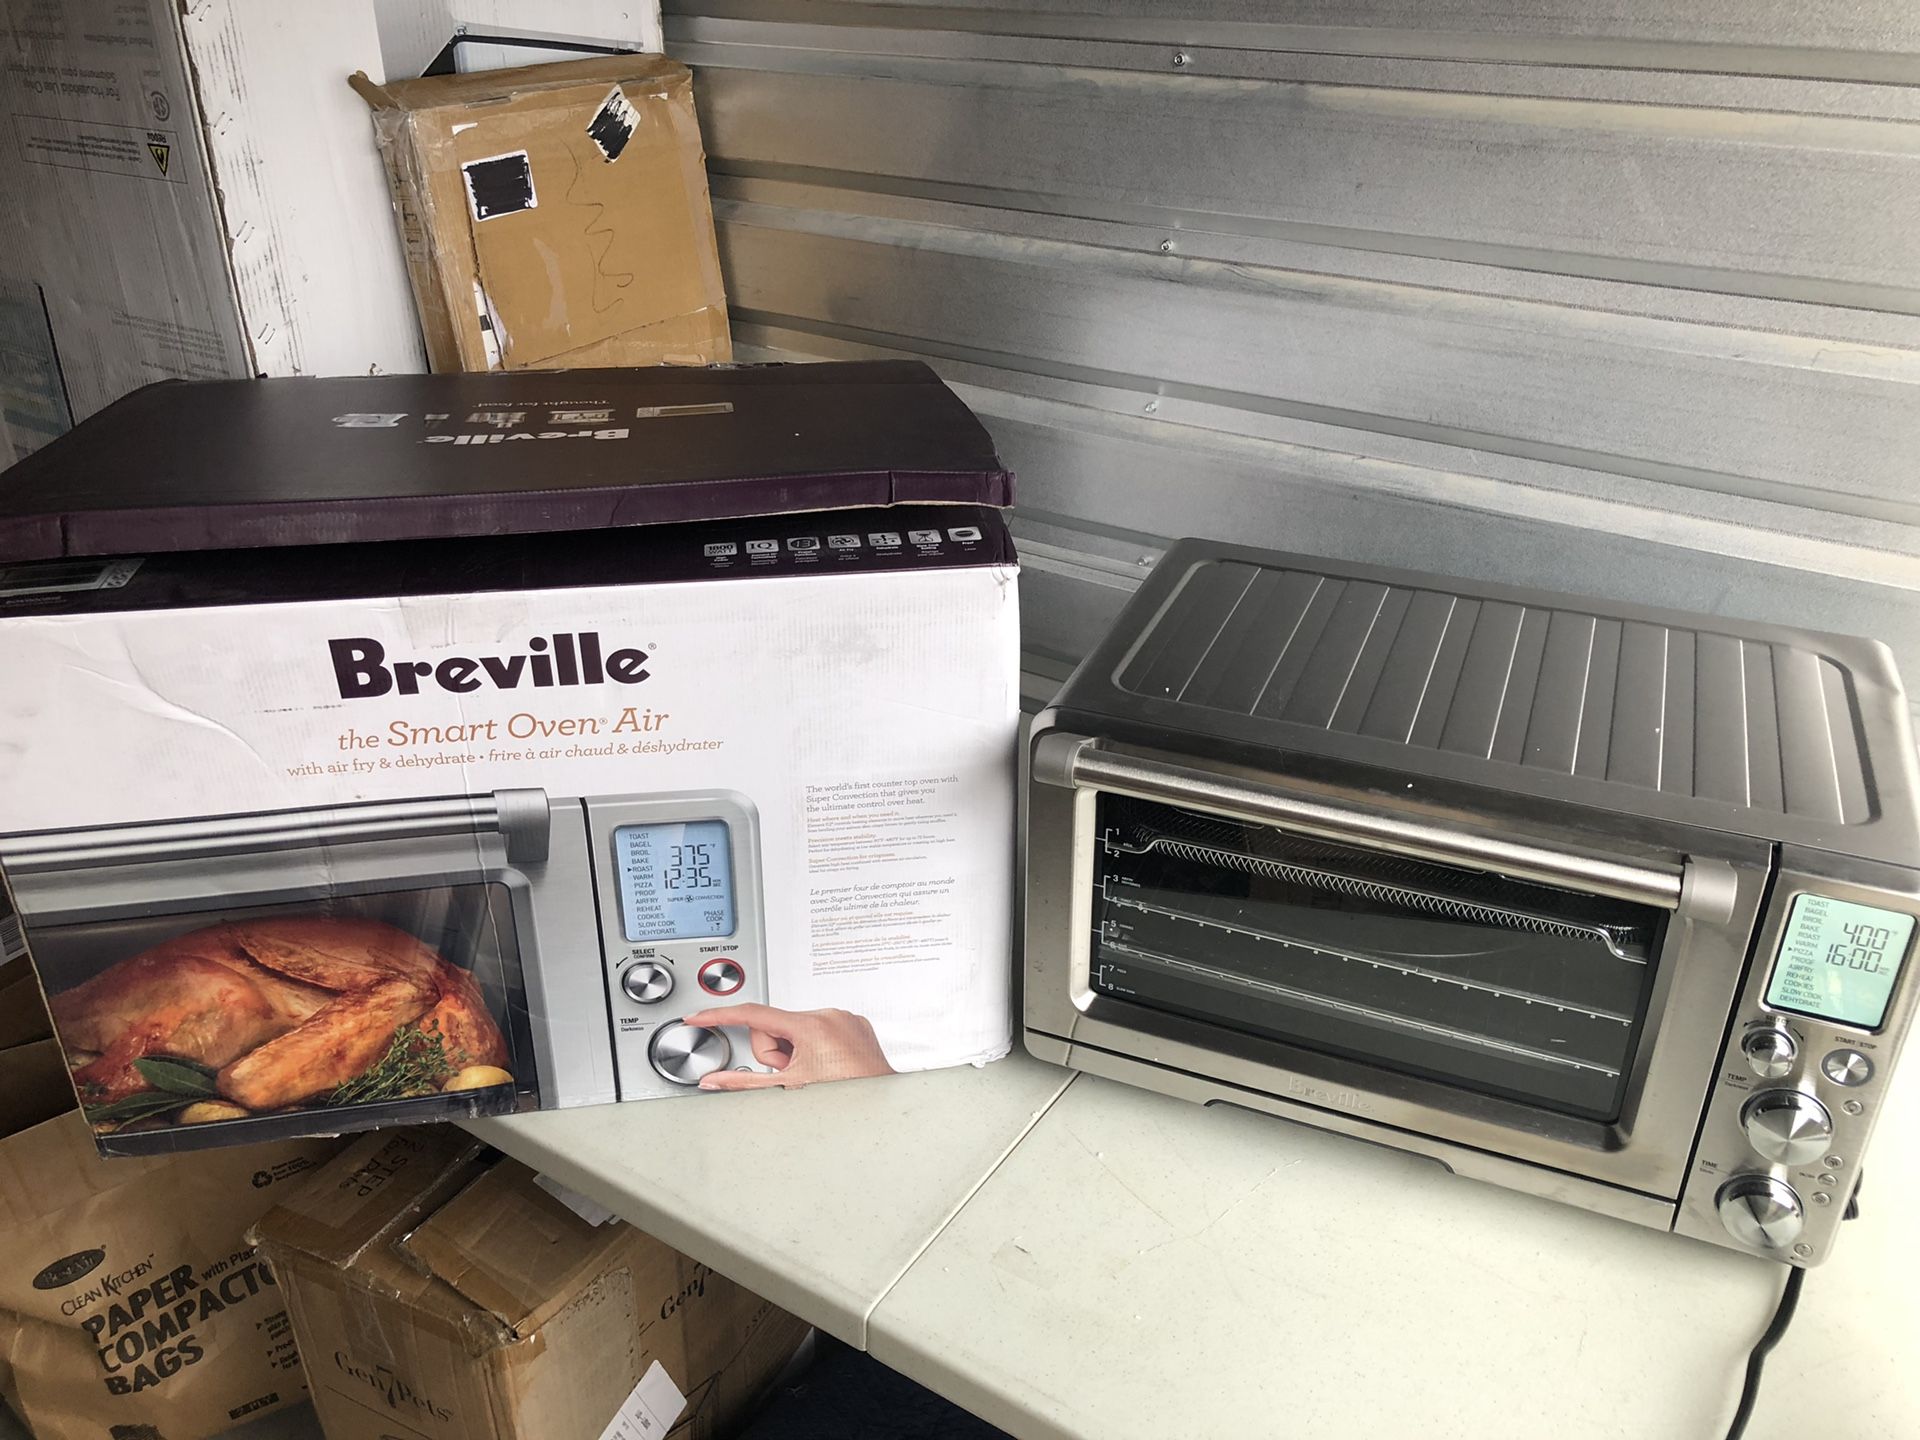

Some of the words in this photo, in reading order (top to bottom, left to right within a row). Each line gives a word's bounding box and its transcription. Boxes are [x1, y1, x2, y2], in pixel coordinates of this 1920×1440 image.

[424, 429, 629, 445] Breville
[328, 631, 652, 699] Breville
[338, 728, 379, 751] the
[387, 716, 498, 748] Smart
[507, 712, 600, 740] Oven
[613, 707, 670, 733] Air
[287, 763, 324, 777] with
[327, 758, 349, 773] air
[352, 755, 375, 774] fry
[379, 755, 391, 768] &
[395, 749, 476, 769] dehydrate
[488, 747, 521, 763] frire
[525, 746, 535, 760] à
[538, 745, 561, 760] air
[564, 742, 614, 758] chaud
[617, 741, 628, 754] &
[632, 738, 724, 756] déshydrater
[824, 782, 853, 792] world's
[854, 782, 870, 790] first
[872, 780, 903, 789] counter
[904, 778, 918, 787] top
[940, 774, 959, 783] with
[806, 795, 831, 804] Super
[832, 791, 879, 801] Convection
[880, 789, 896, 797] that
[898, 788, 919, 798] gives
[920, 787, 936, 796] you
[807, 804, 820, 812] the
[821, 802, 856, 812] ultimate
[857, 800, 886, 809] control
[887, 798, 906, 807] over
[906, 796, 926, 805] heat.
[1116, 828, 1120, 836] 1
[670, 844, 710, 867] 375
[1113, 850, 1120, 858] 2
[664, 867, 712, 889] 12:35
[1113, 874, 1119, 882] 3
[810, 888, 820, 896] Le
[821, 886, 852, 897] premier
[853, 884, 868, 892] four
[881, 881, 915, 891] comptoir
[928, 877, 955, 886] monde
[635, 897, 659, 905] AIRFRY
[829, 895, 853, 904] Super
[854, 891, 897, 901] Convection
[899, 890, 912, 899] qui
[810, 903, 842, 914] contrôle
[843, 902, 868, 911] ultime
[880, 900, 888, 908] la
[889, 898, 920, 907] chaleur.
[1808, 899, 1830, 908] TOAST
[1804, 907, 1828, 917] BAGEL
[1110, 920, 1117, 928] 5
[1800, 923, 1820, 932] BAKE
[639, 928, 676, 936] DEHYDRATE
[1797, 931, 1821, 941] ROAST
[1843, 922, 1890, 951] 400
[1795, 940, 1818, 949] WARM
[1793, 947, 1813, 956] PIZZA
[1791, 955, 1815, 965] PROOF
[1825, 943, 1883, 973] 16:00
[1109, 964, 1115, 972] 7
[1788, 964, 1814, 974] AIRFRY
[1786, 971, 1813, 981] REHEAT
[1108, 983, 1114, 991] 8
[1784, 979, 1814, 991] COOKIES
[1782, 987, 1803, 996] SLOW
[1803, 990, 1823, 1000] COOK
[1779, 994, 1821, 1008] DEHYDRATE
[1835, 1036, 1856, 1046] START
[1727, 1073, 1747, 1082] TEMP
[1288, 1075, 1371, 1111] Breville
[1702, 1160, 1718, 1169] TIME
[358, 1154, 408, 1196] STEP
[61, 1287, 103, 1316] CLEAN
[101, 1259, 153, 1297] KITCHEN
[81, 1264, 199, 1343] PAPER
[201, 1261, 228, 1281] with
[104, 1334, 204, 1395] BAGS
